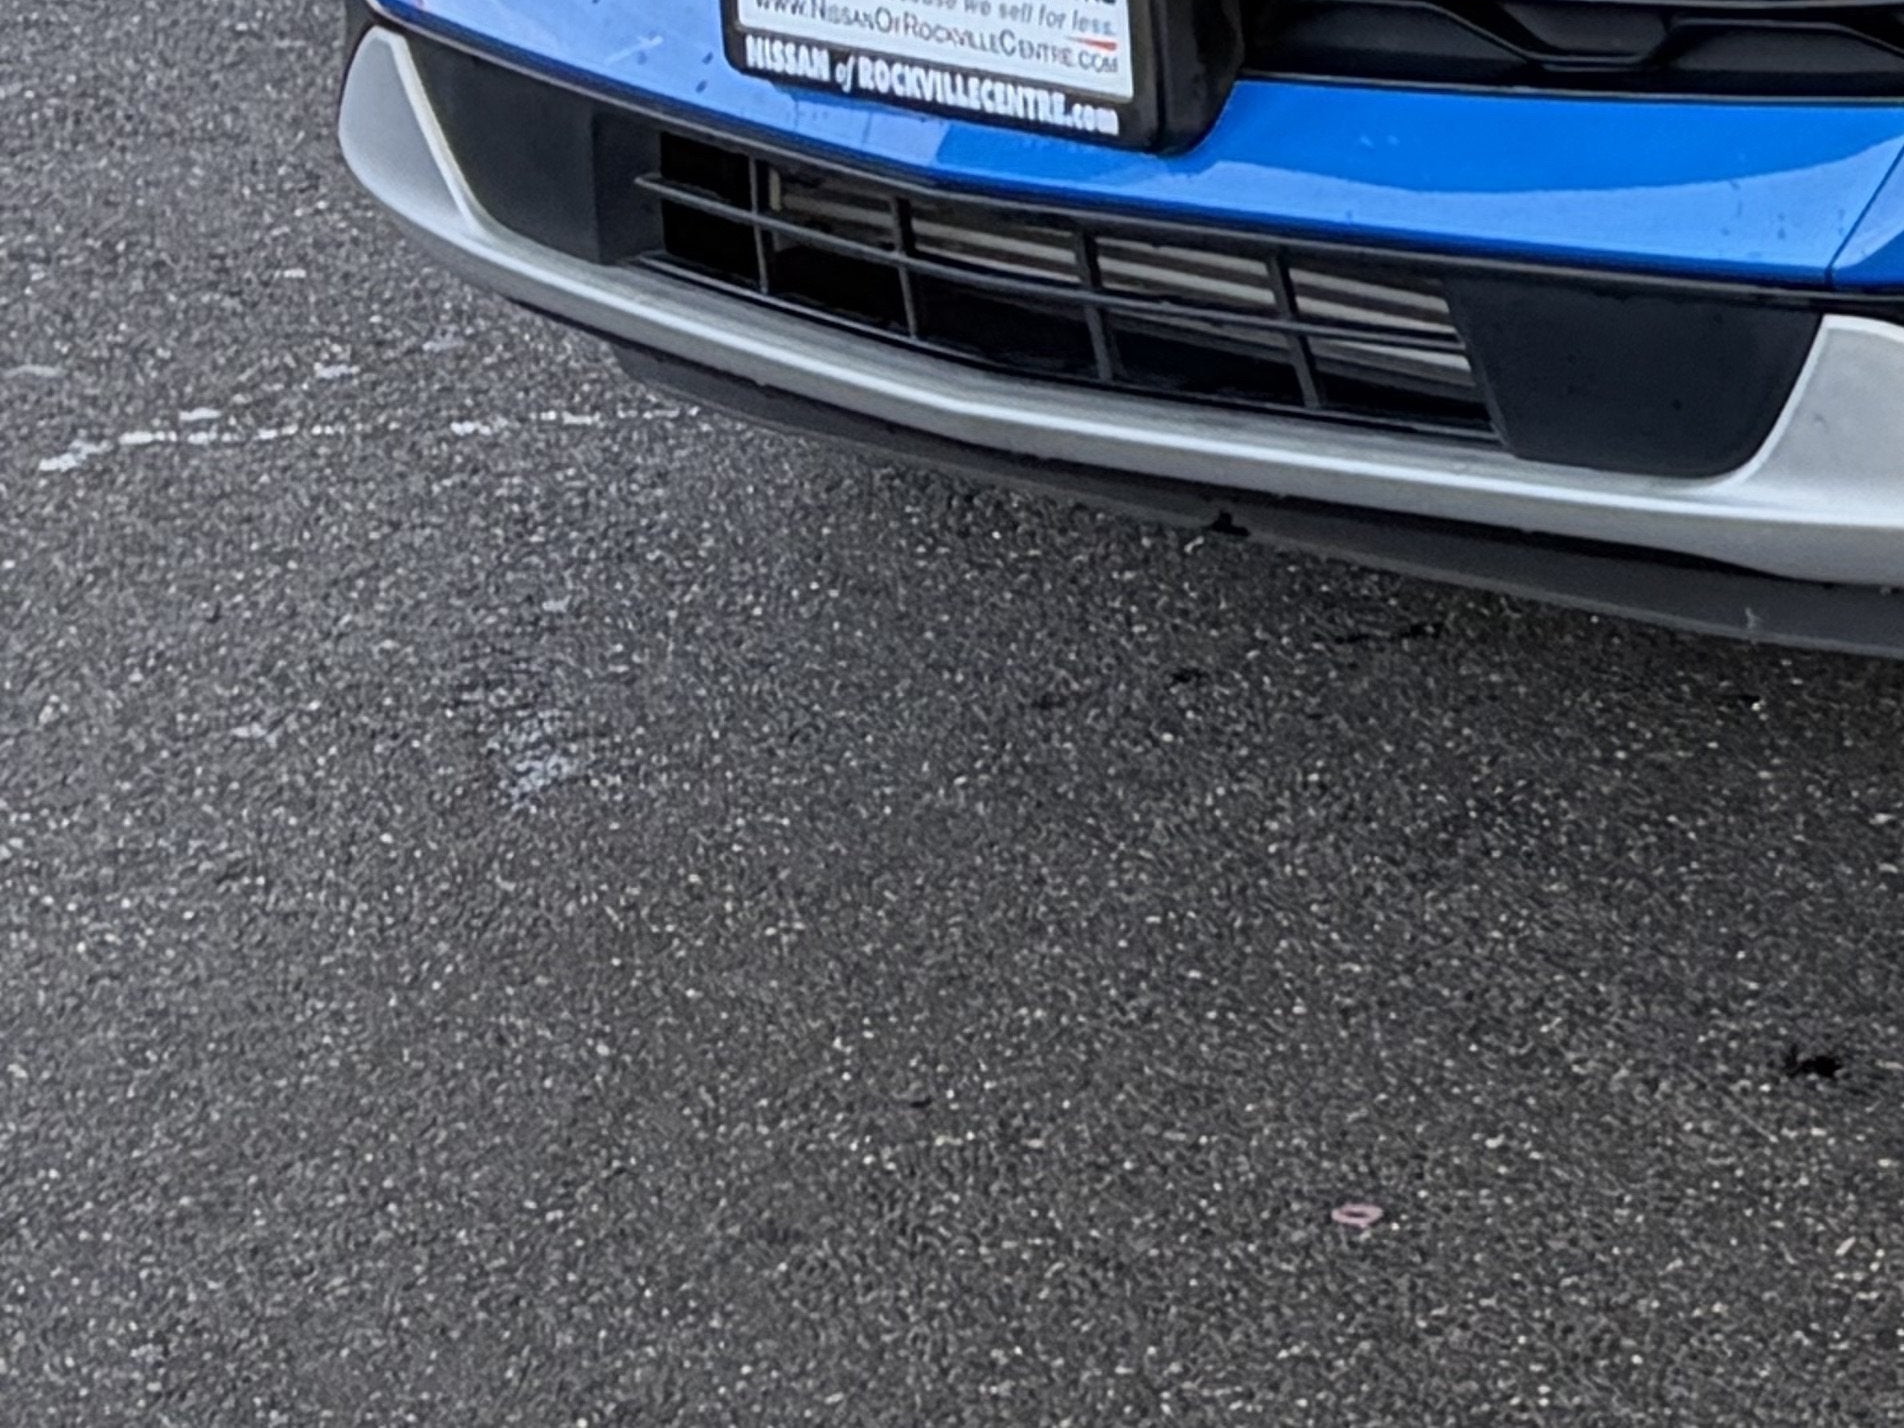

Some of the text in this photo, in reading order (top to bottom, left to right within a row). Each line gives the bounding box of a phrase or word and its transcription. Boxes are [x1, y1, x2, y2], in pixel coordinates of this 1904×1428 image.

[1000, 2, 1032, 23] sell
[1038, 5, 1066, 30] for
[745, 34, 830, 82] NISSAN
[835, 54, 855, 94] of
